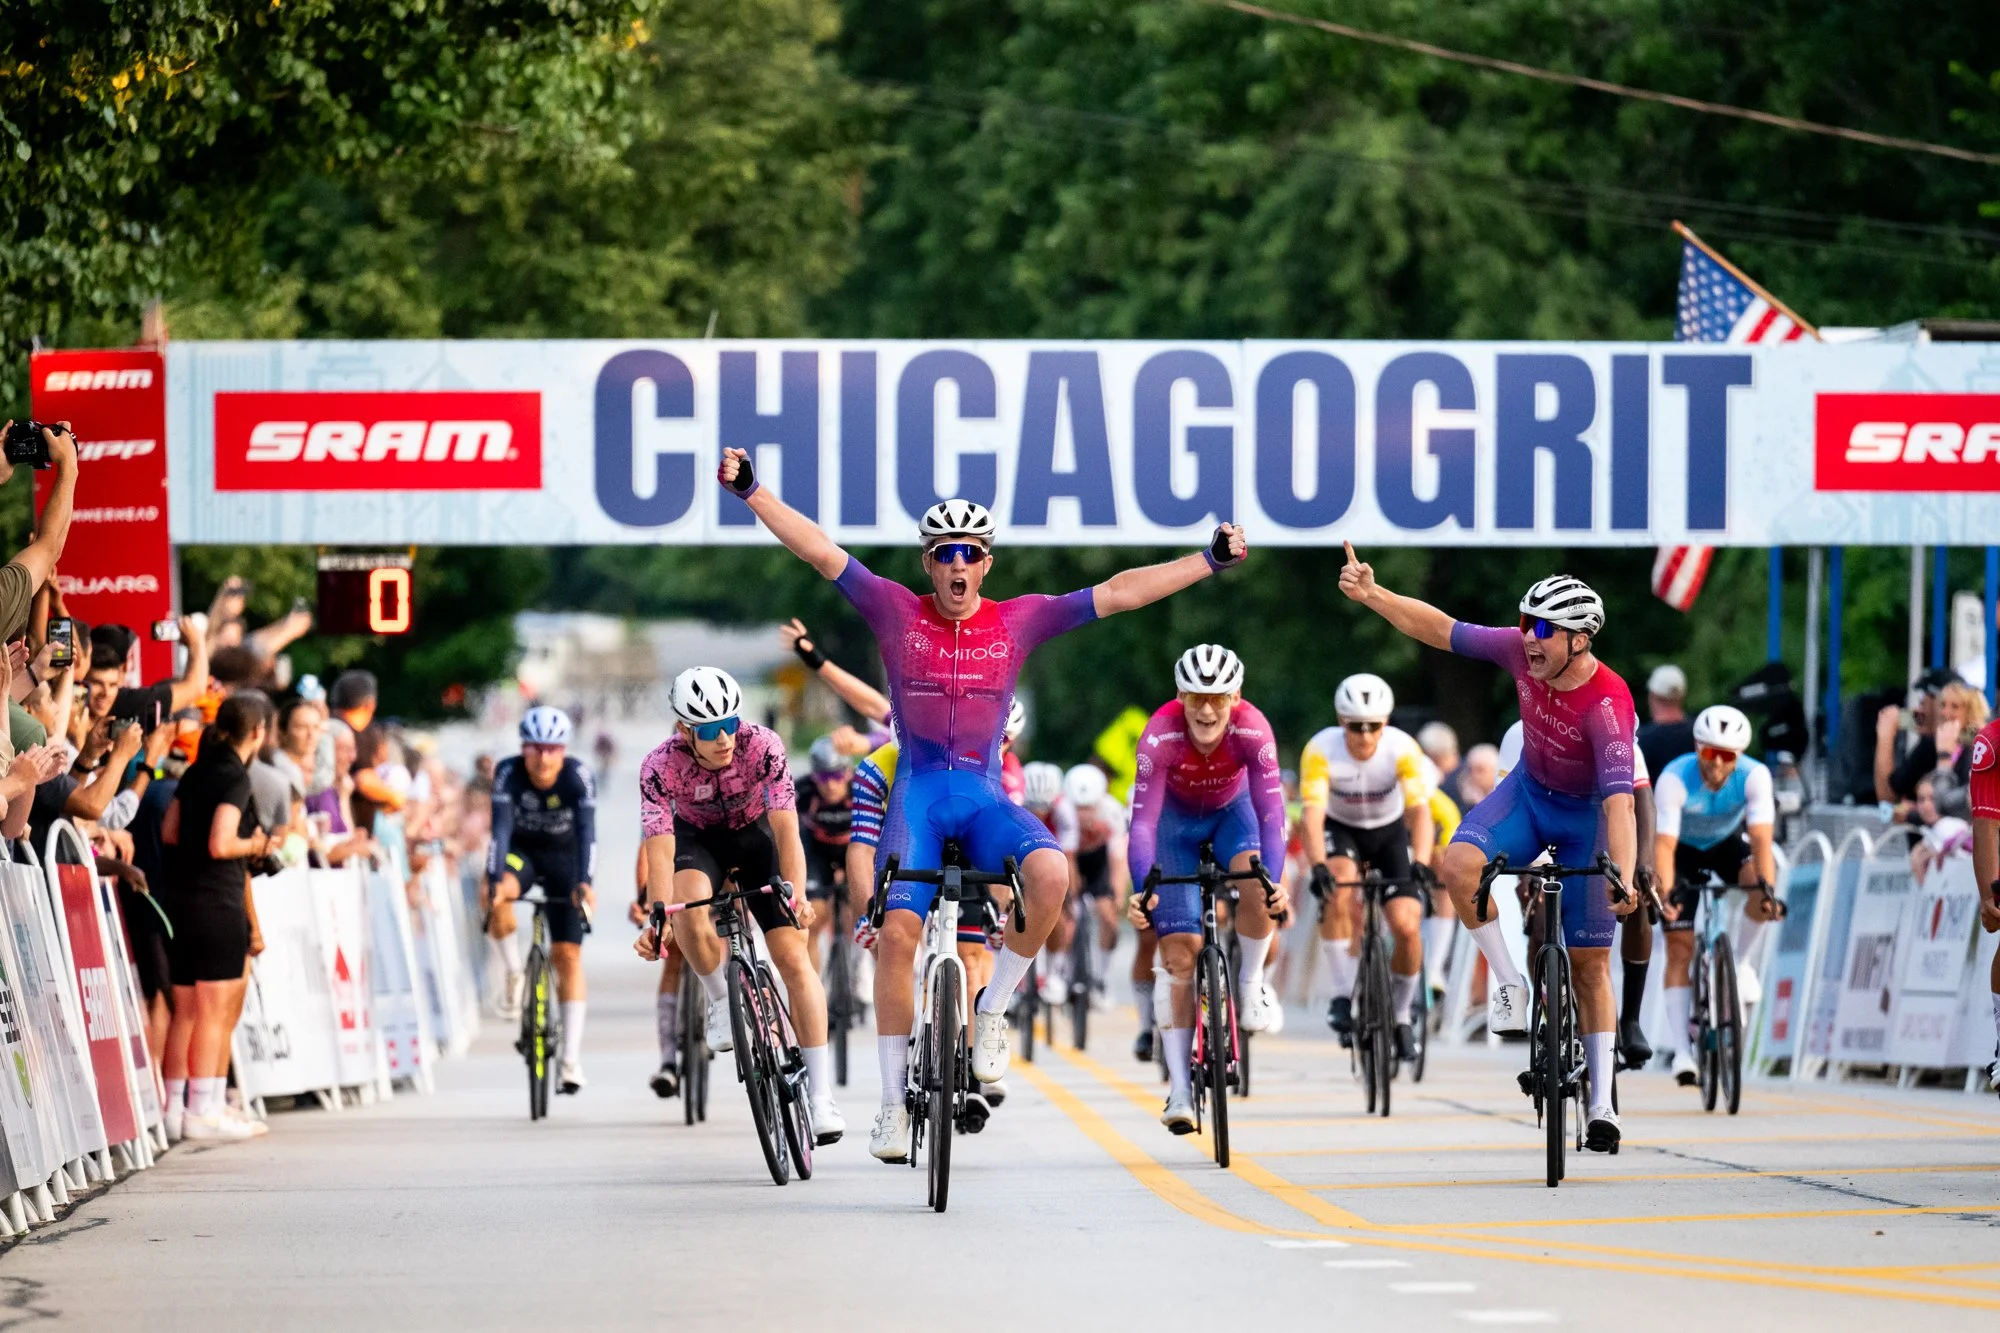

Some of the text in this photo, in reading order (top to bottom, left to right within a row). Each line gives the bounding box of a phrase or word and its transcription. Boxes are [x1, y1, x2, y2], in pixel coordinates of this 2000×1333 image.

[44, 368, 154, 392] SRAM
[77, 438, 157, 461] IPP
[246, 420, 514, 462] SRAM
[594, 348, 1753, 530] CHICAGOGRIT
[1845, 421, 2000, 463] SRA
[71, 506, 159, 523] MMERHEAD
[368, 567, 410, 633] 0
